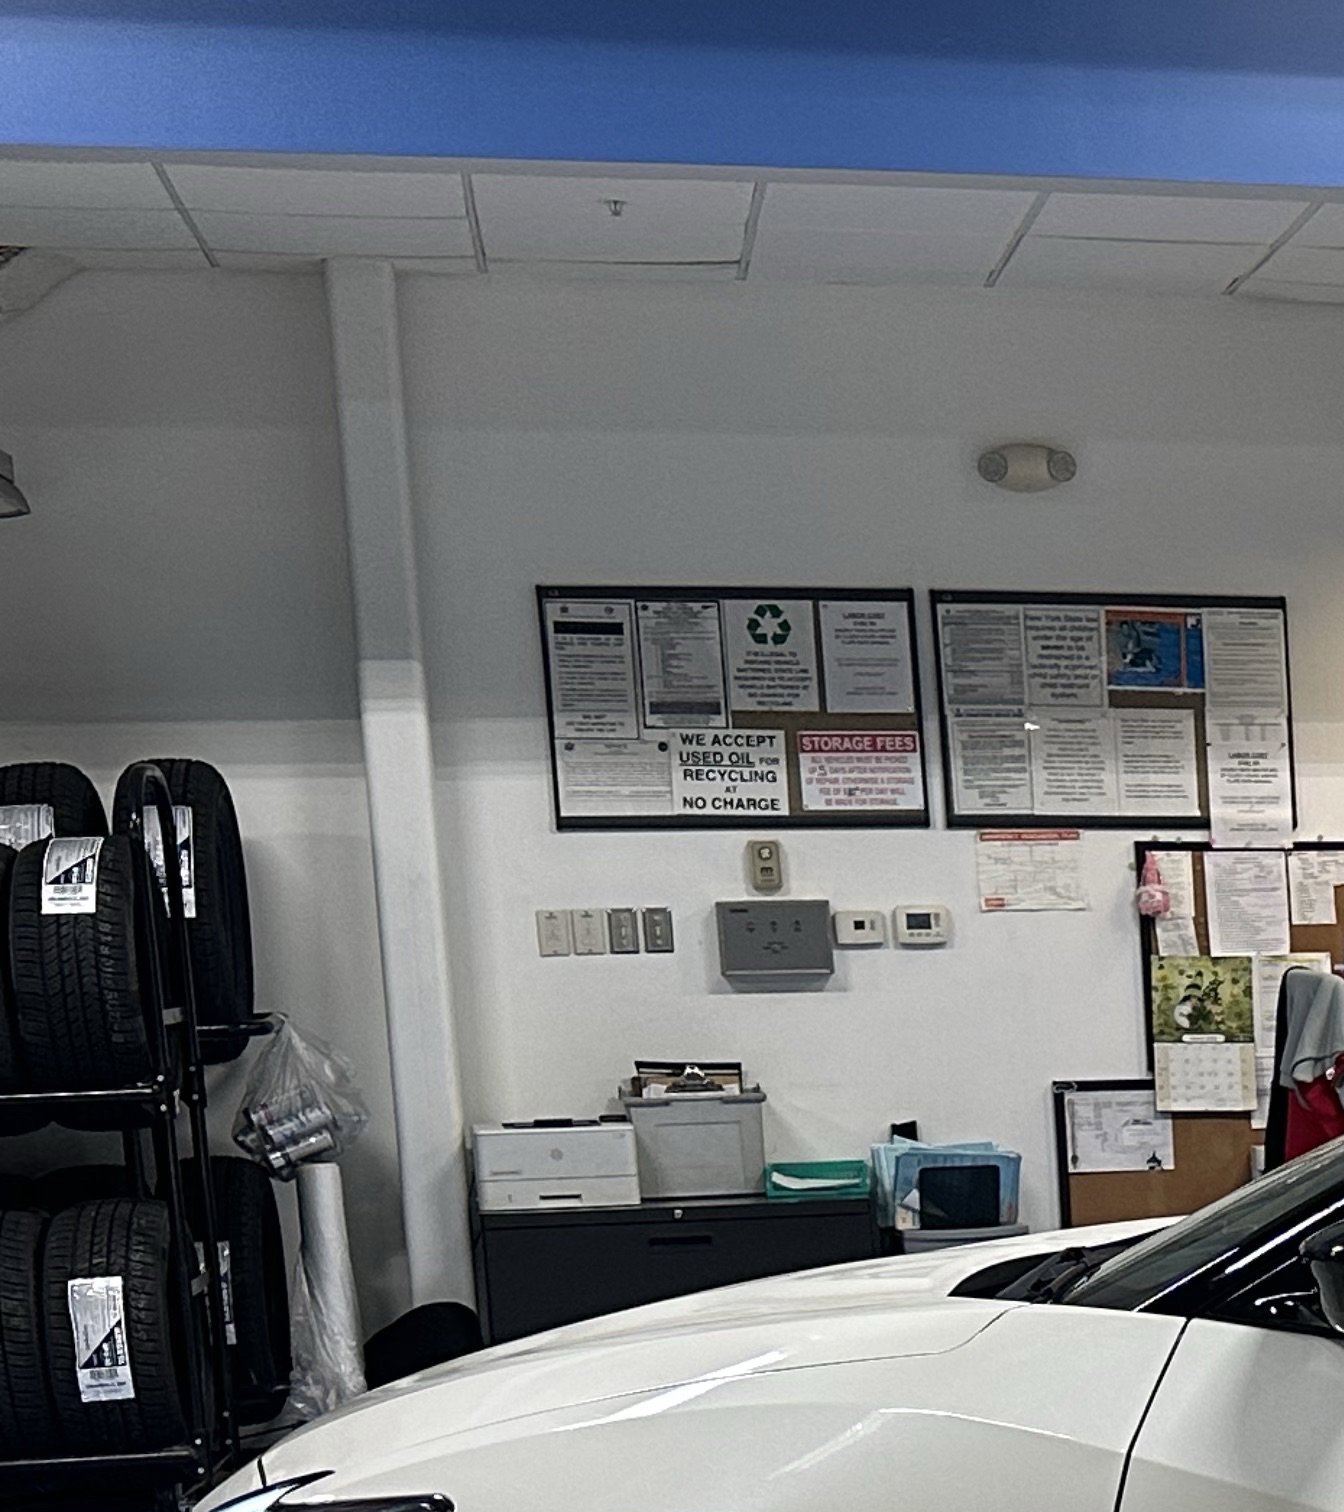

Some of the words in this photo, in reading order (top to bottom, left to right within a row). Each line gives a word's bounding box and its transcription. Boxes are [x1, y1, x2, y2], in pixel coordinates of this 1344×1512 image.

[680, 732, 706, 746] WE
[711, 734, 776, 747] ACCEPT
[802, 736, 873, 751] STORAGE
[875, 736, 915, 751] FEES
[679, 751, 724, 765] USED
[728, 751, 755, 766] OIL
[759, 757, 780, 766] FOR
[683, 769, 777, 783] RECYCLING
[724, 785, 738, 793] AT
[682, 796, 707, 810] NO
[711, 797, 782, 811] CHARGE
